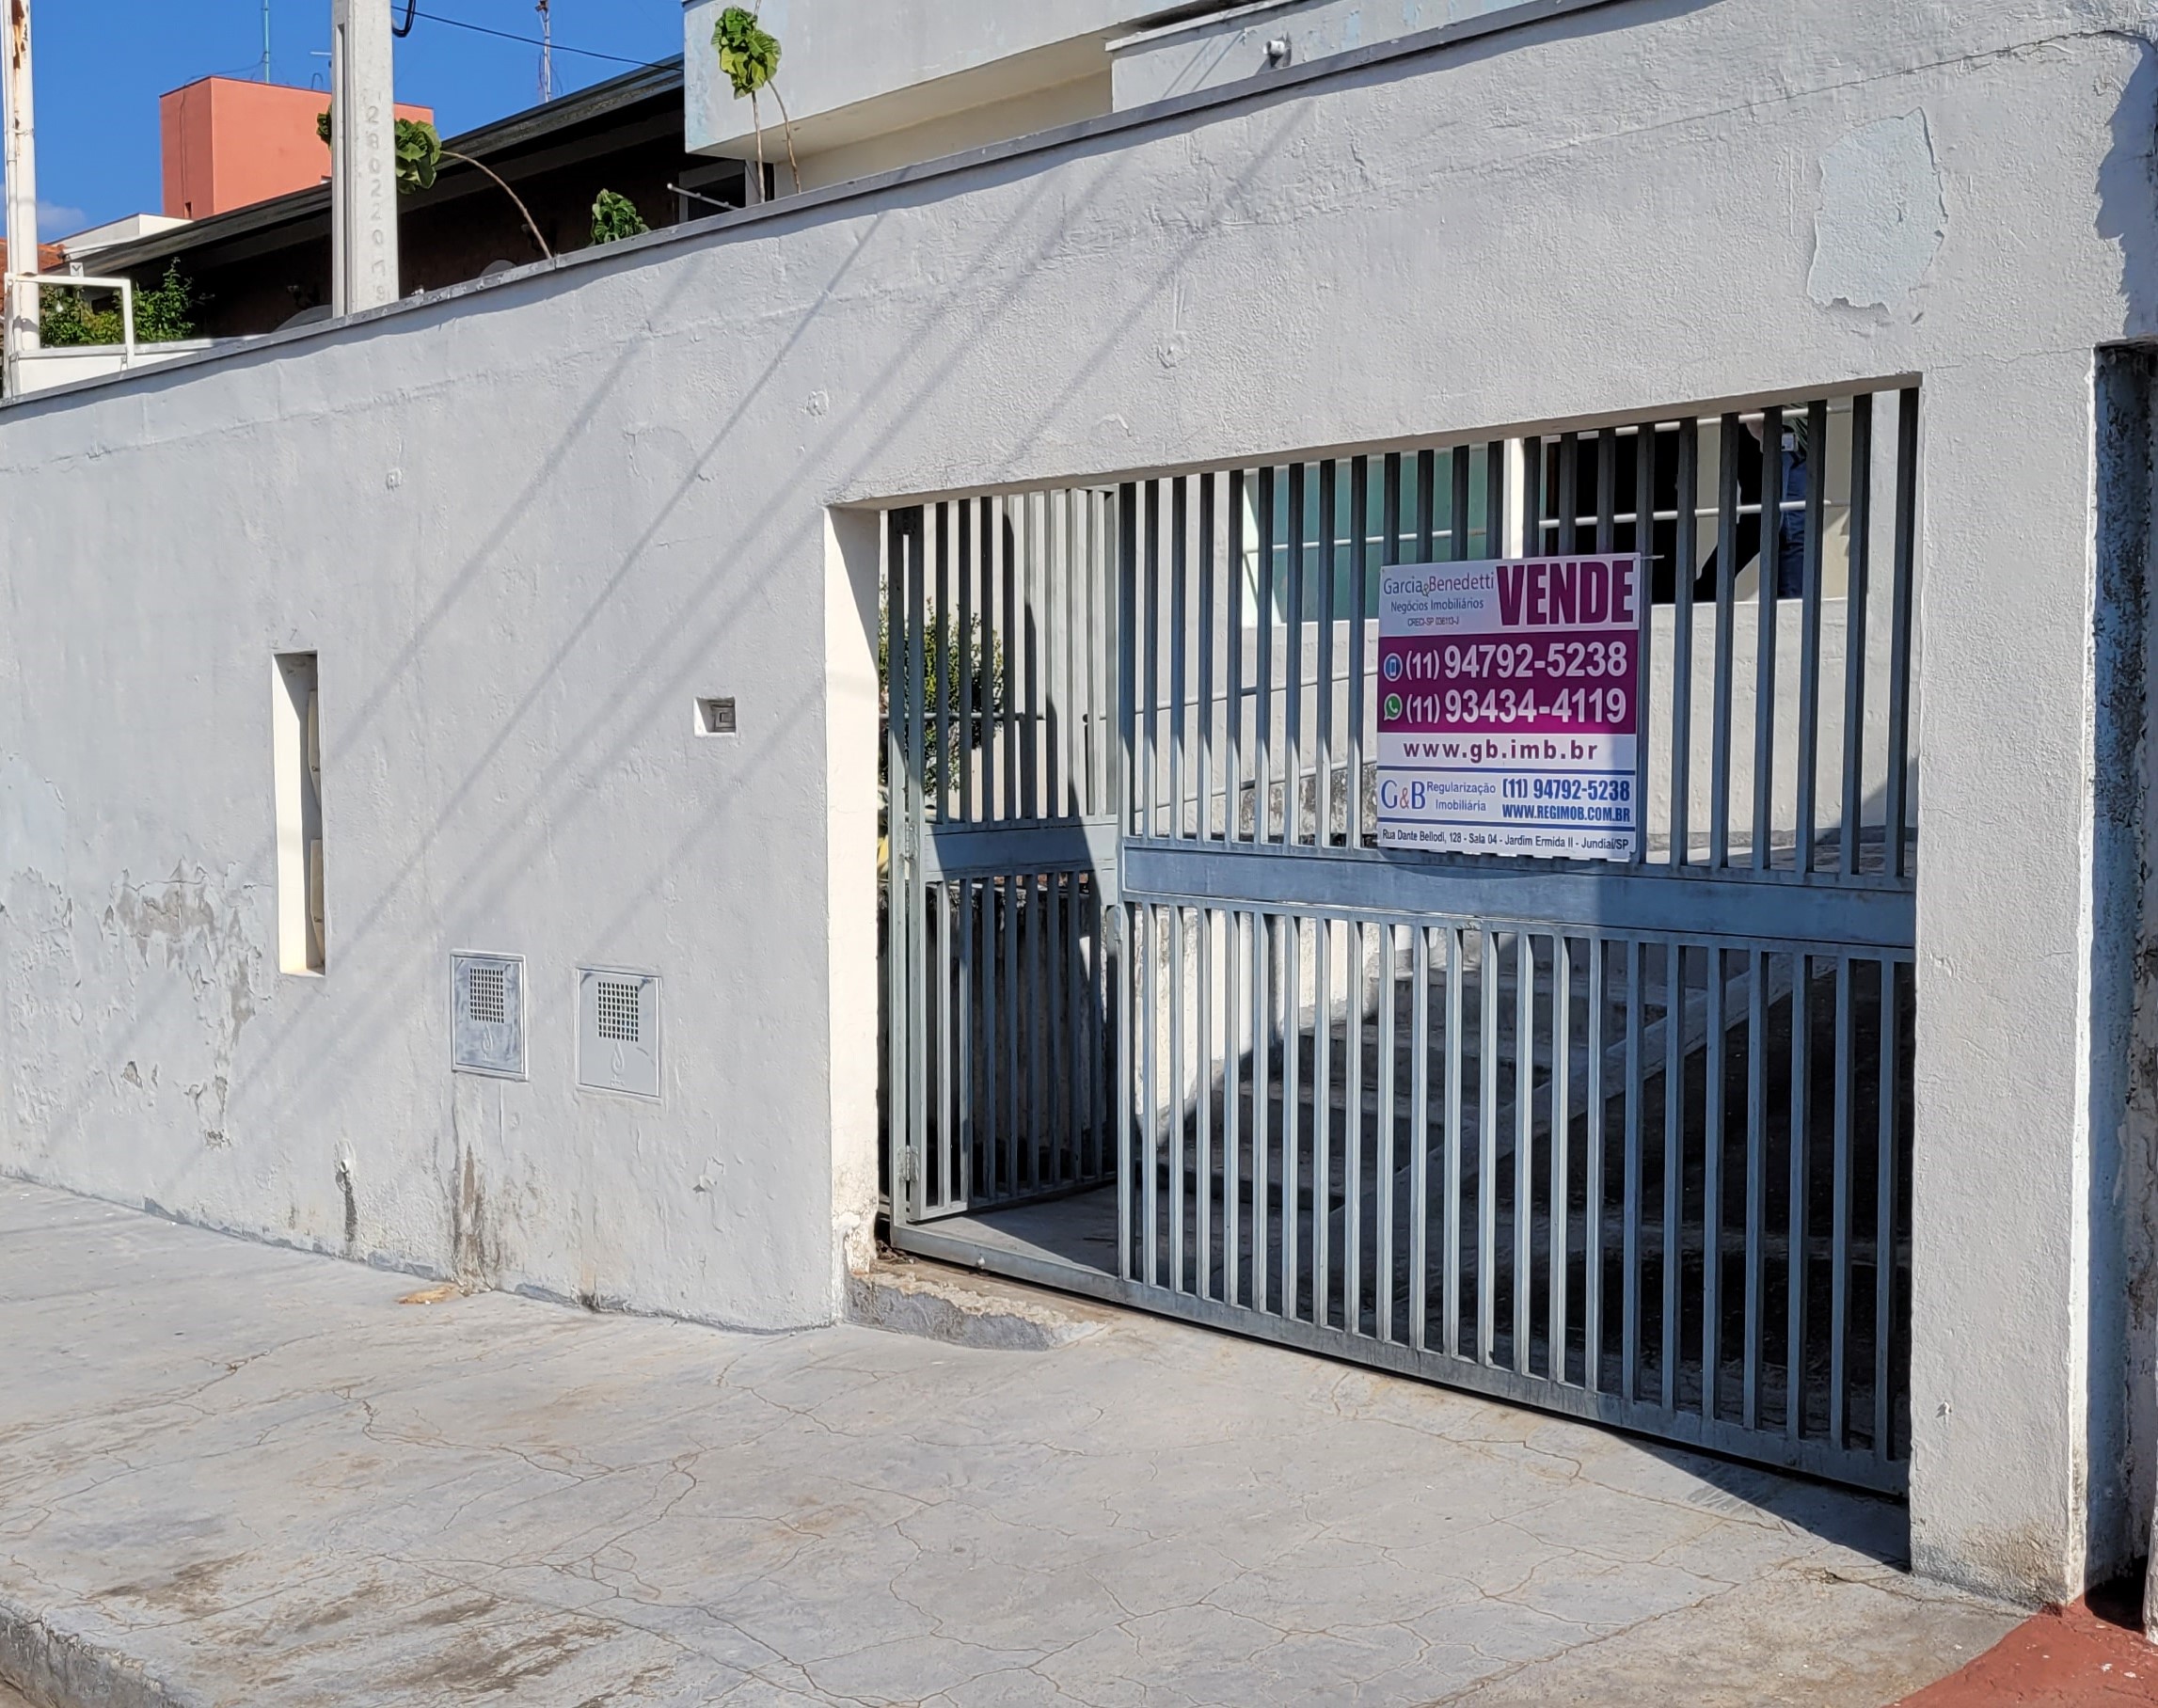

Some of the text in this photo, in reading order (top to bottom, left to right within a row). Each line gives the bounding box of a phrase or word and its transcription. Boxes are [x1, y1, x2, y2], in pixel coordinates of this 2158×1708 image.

[1496, 560, 1634, 626] VENDE
[1391, 596, 1484, 614] Negócios Imobiliários
[1405, 641, 1627, 680] (11) 94792-5238
[1405, 688, 1626, 724] (11) 93434-4119
[1403, 739, 1598, 764] www.gb.imb.br
[1381, 779, 1426, 810] G&B
[1426, 781, 1496, 796] Regularização
[1502, 778, 1630, 801] (11) 94792-5238
[1436, 799, 1486, 812] Imobiliária
[1502, 804, 1630, 822] WWW.REGIMOB.COM.BR
[1382, 829, 1395, 840] Rua
[1397, 830, 1418, 841] Dante
[1450, 832, 1462, 843] 128
[1468, 833, 1485, 844] Sala
[1487, 834, 1498, 844] 04
[1505, 834, 1532, 846] Jardim
[1535, 836, 1565, 847] Ermida
